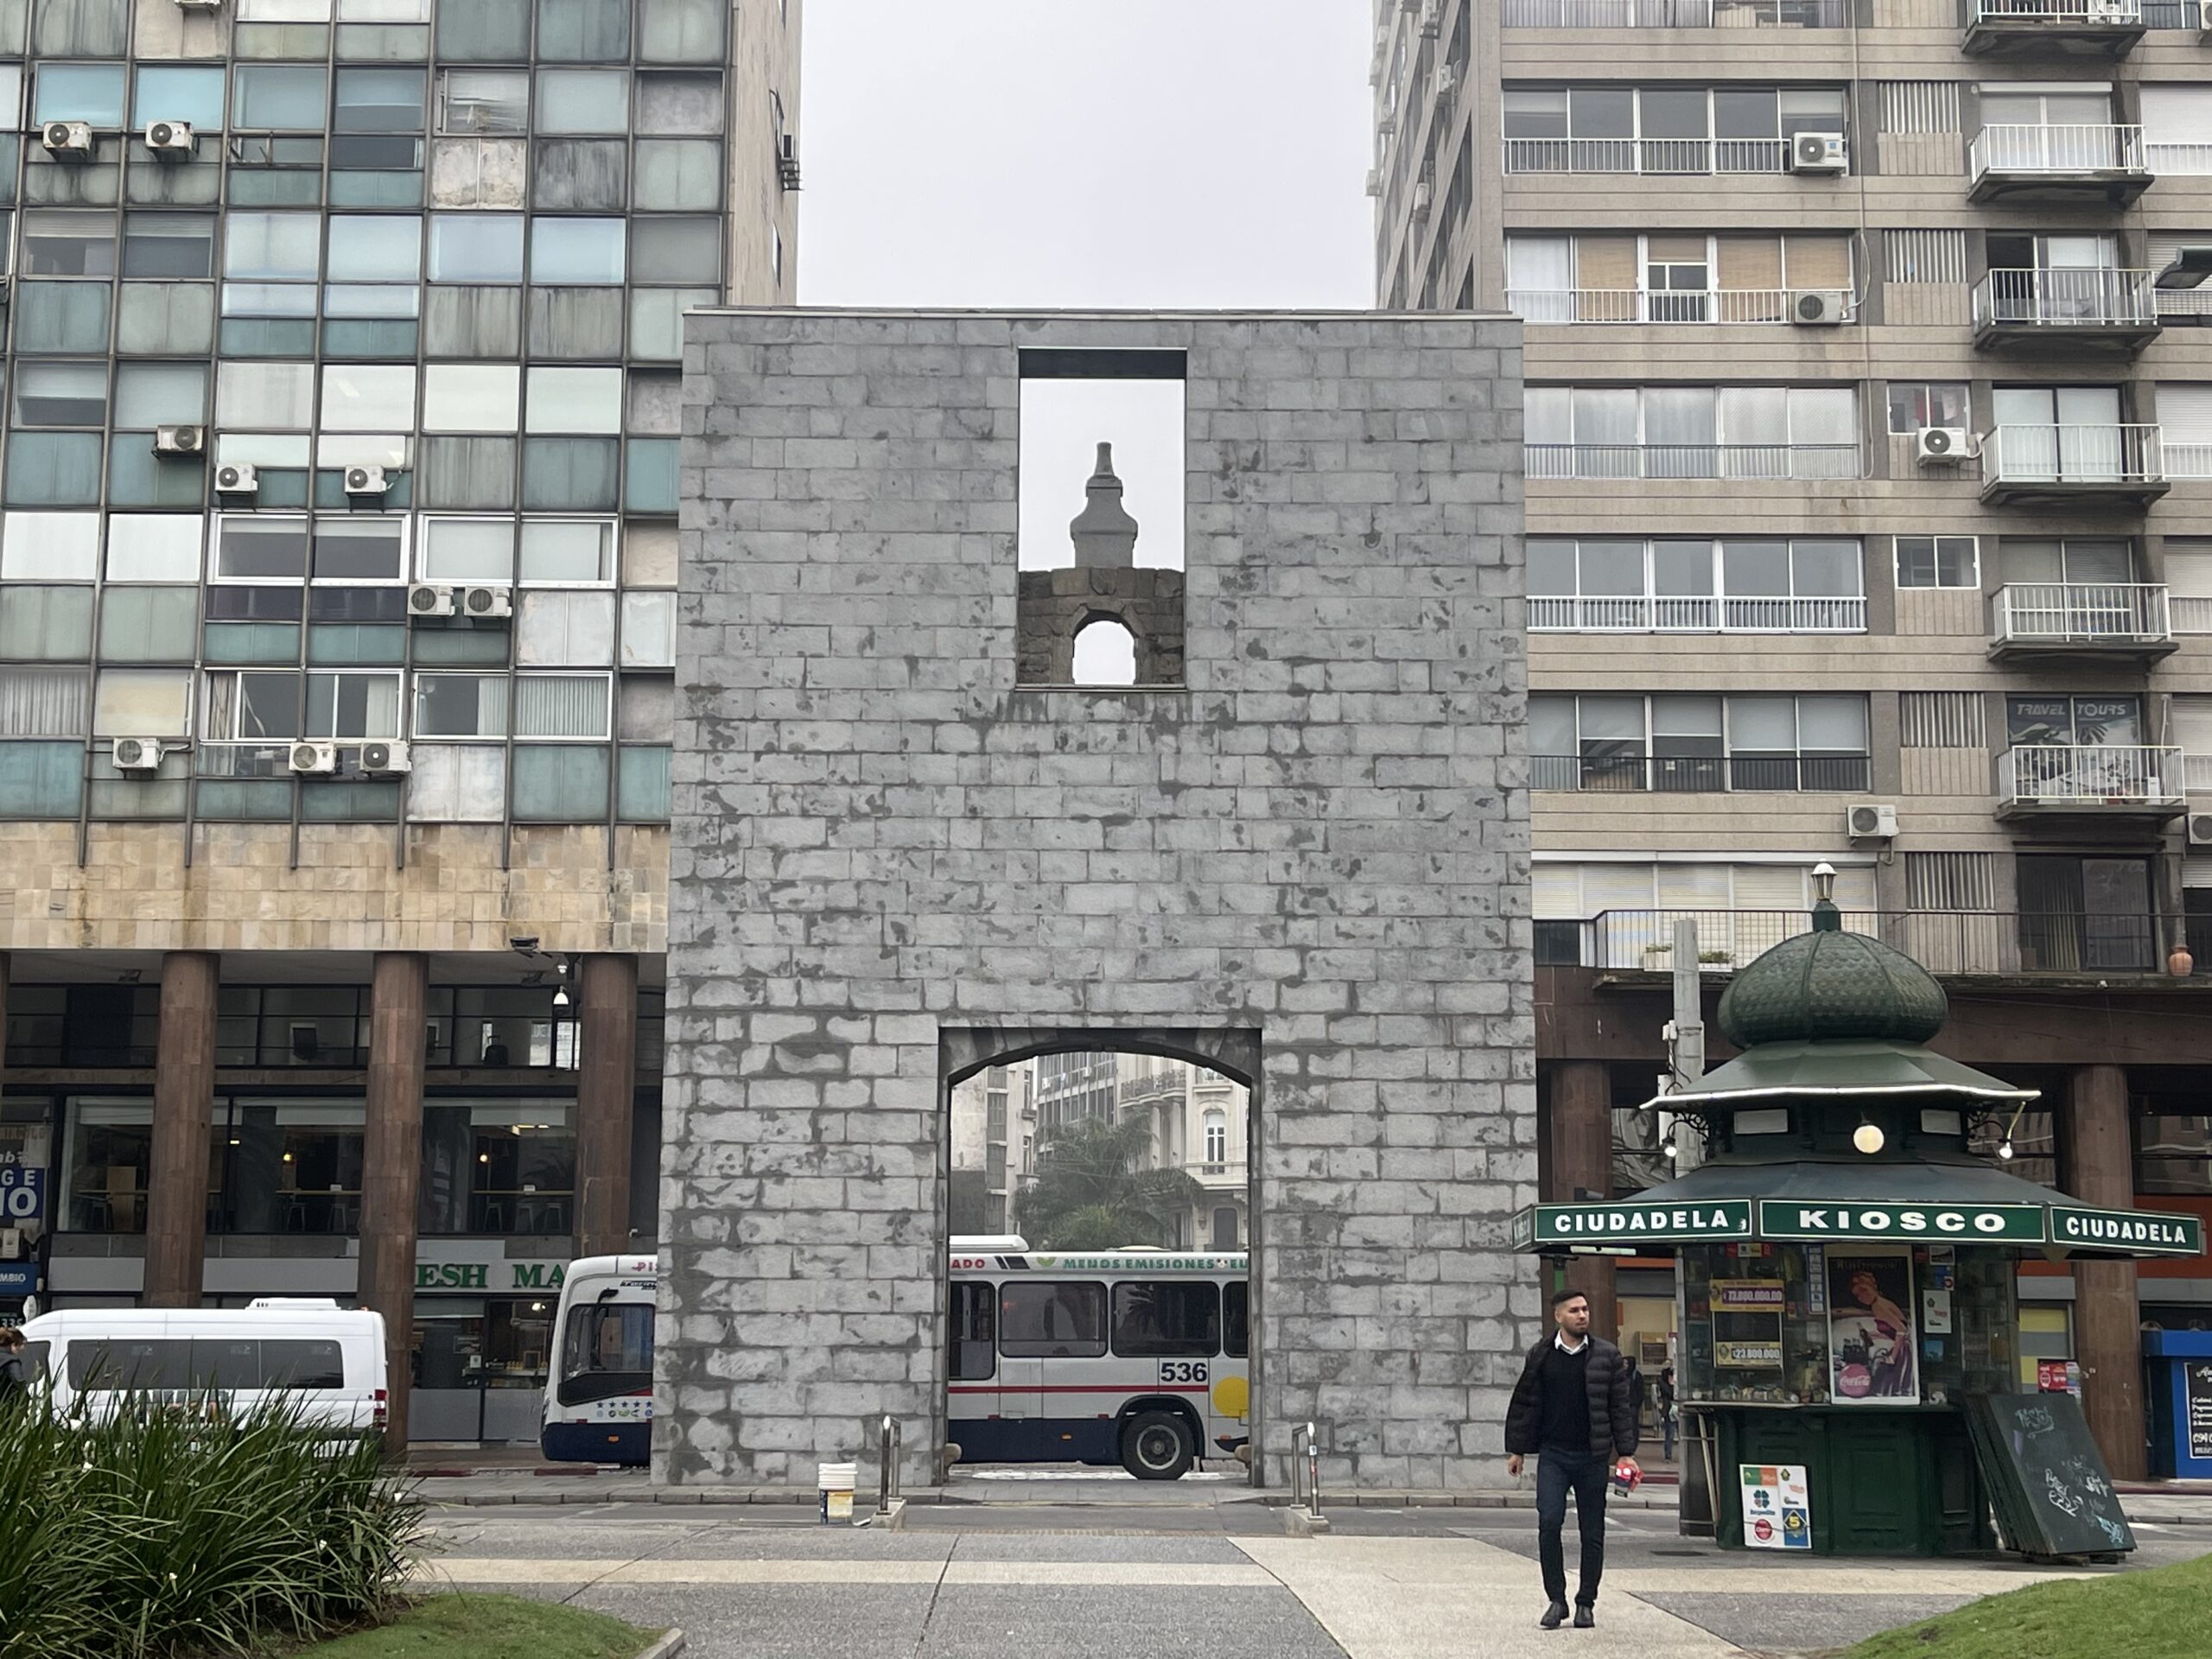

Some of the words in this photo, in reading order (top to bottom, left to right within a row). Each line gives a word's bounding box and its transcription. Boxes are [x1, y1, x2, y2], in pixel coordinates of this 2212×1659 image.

[2017, 703, 2066, 715] TRAVEL
[2076, 703, 2126, 716] TOURS
[1554, 1210, 1729, 1232] CIUDADELA
[1799, 1210, 2006, 1232] KIOSCO
[2066, 1217, 2187, 1243] CIUDADELA
[636, 1262, 658, 1272] PI
[951, 1259, 985, 1269] ADO
[1064, 1258, 1121, 1269] MENOS
[1126, 1257, 1214, 1269] EMISIONES
[1160, 1363, 1207, 1382] 536
